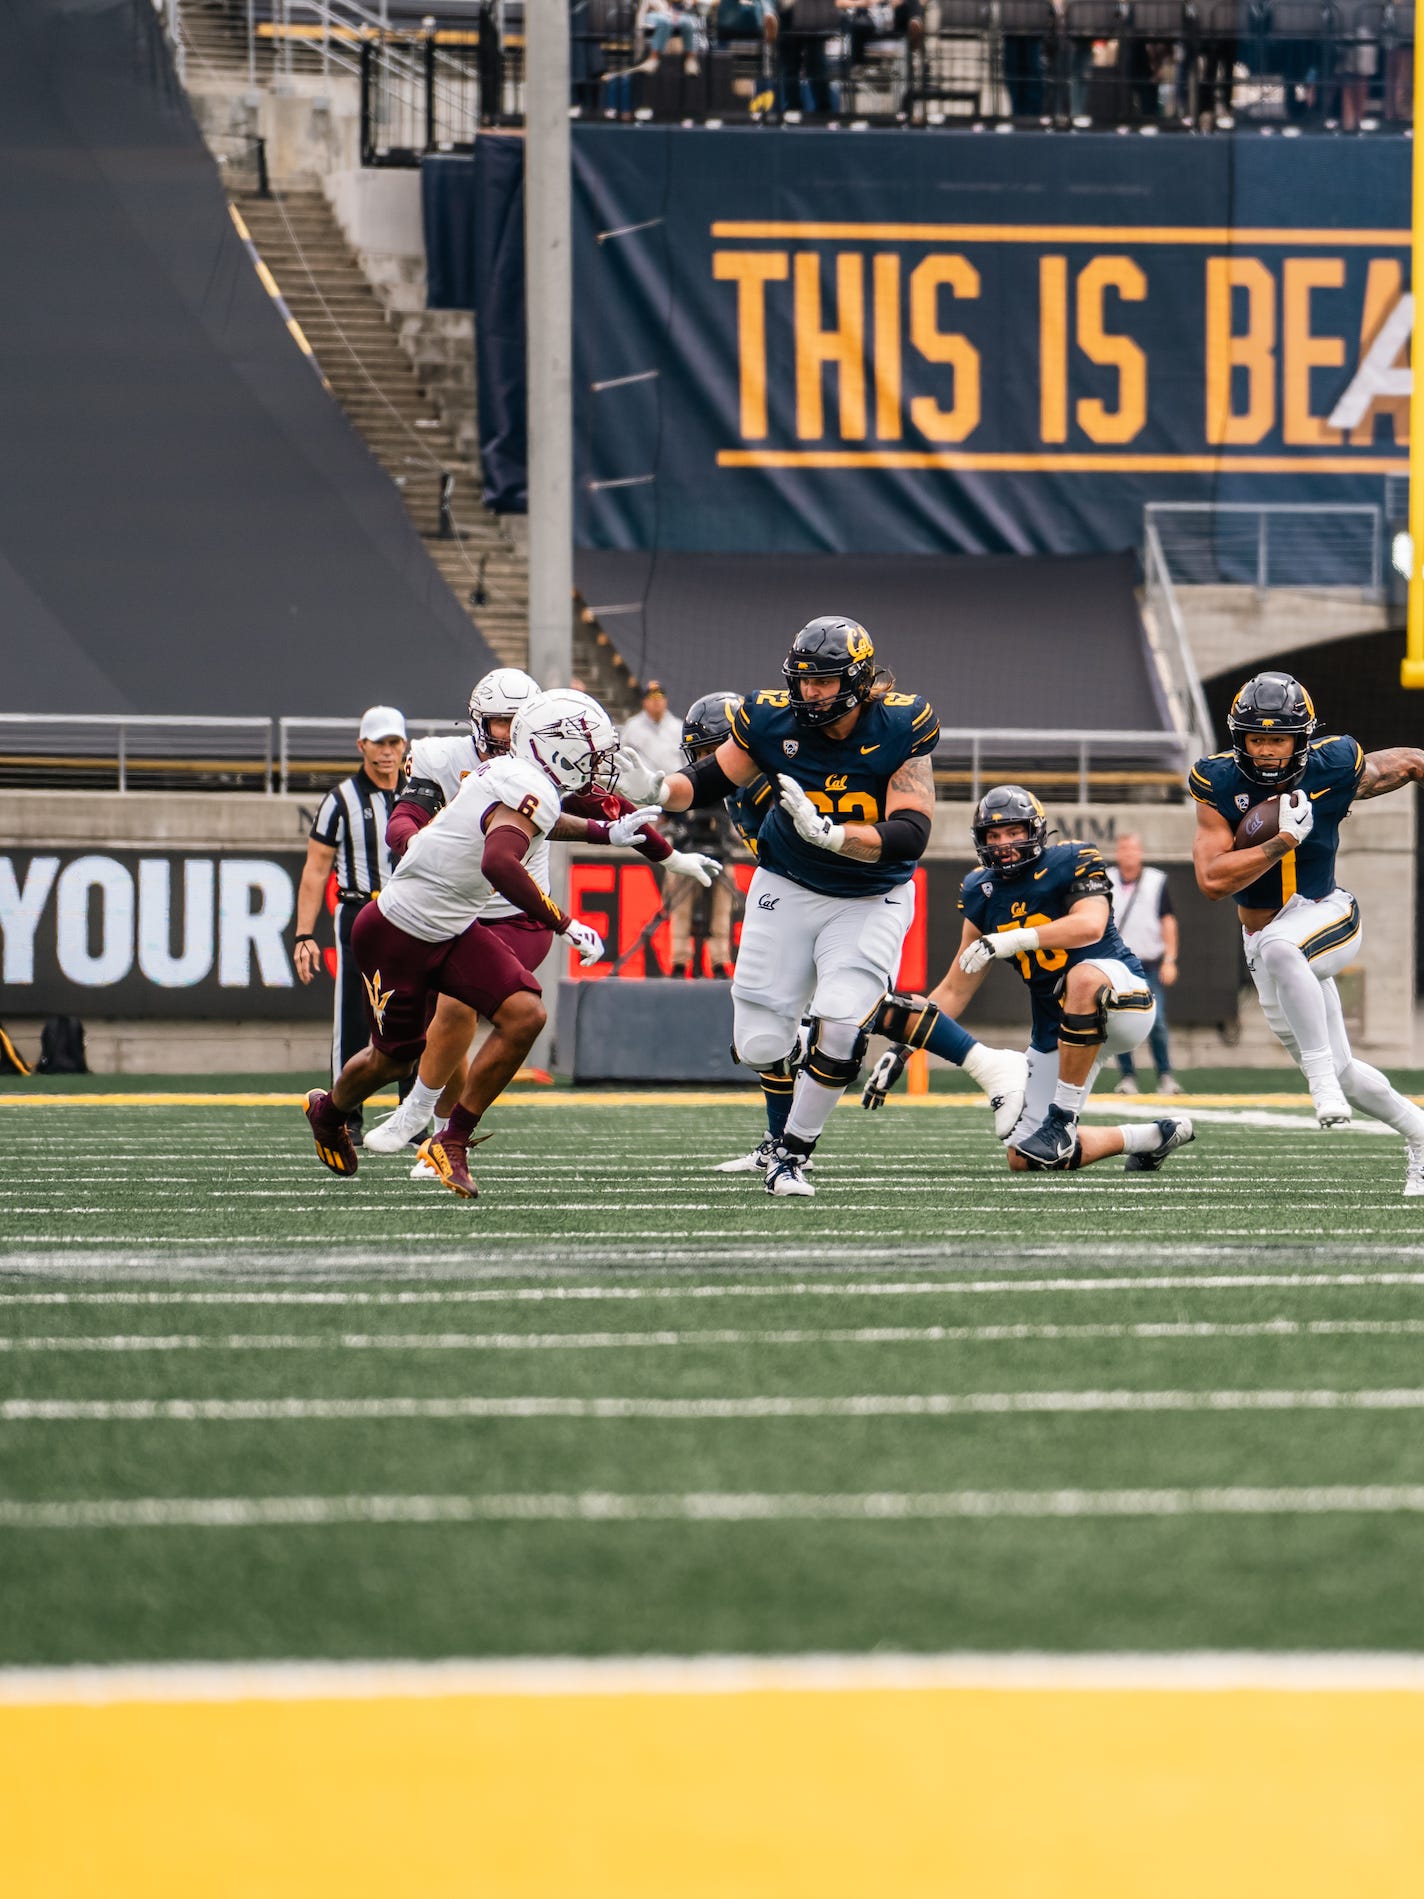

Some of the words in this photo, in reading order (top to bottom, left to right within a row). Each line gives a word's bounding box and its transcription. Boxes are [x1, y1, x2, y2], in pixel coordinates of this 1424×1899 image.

[712, 250, 981, 443] THIS
[1040, 254, 1147, 444] IS
[825, 773, 849, 792] Cal
[517, 793, 542, 820] 6
[1245, 812, 1265, 837] Cal
[757, 892, 781, 911] Cal
[1010, 901, 1029, 919] Cal
[0, 855, 295, 988] YOUR
